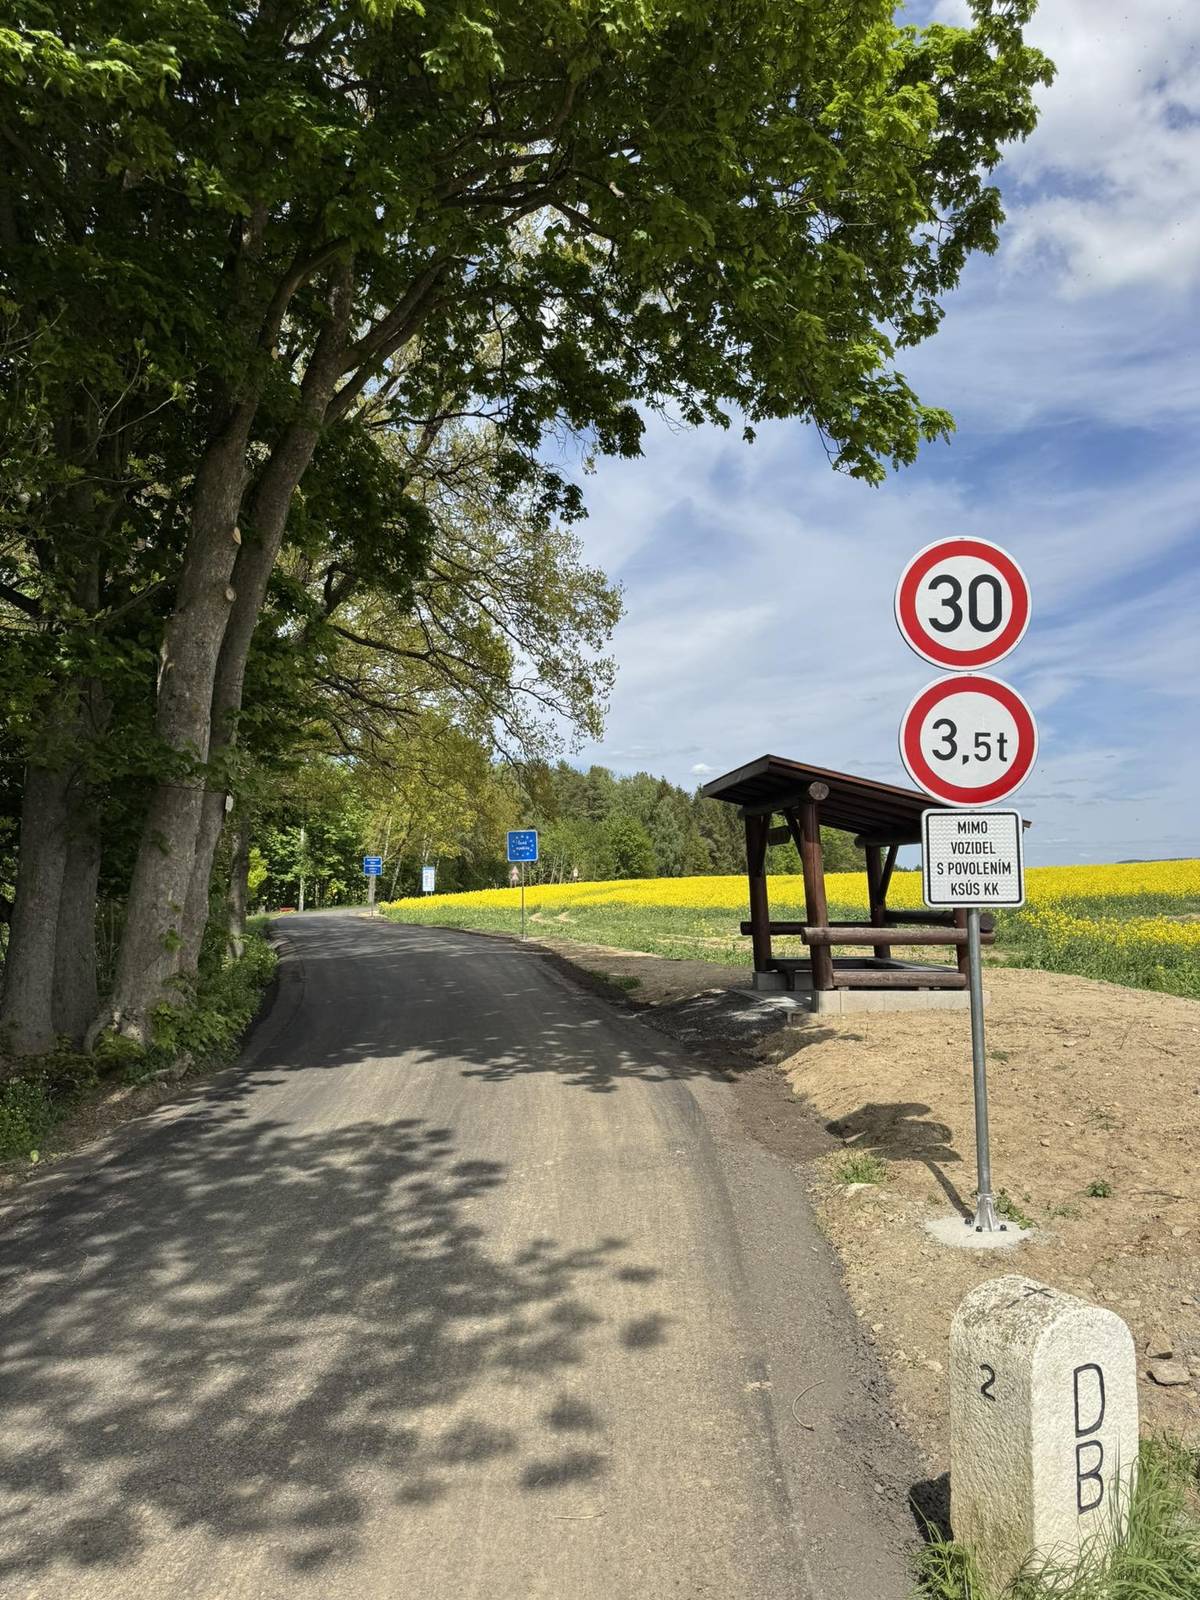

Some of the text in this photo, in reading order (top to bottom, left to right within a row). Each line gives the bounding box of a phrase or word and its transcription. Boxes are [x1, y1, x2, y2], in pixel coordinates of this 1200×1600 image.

[928, 574, 1003, 633] 30
[957, 821, 988, 834] MIMO
[951, 841, 996, 855] VOZIDEL
[937, 859, 1012, 875] S POVOLENÍM
[951, 880, 1000, 896] KSÚS KK
